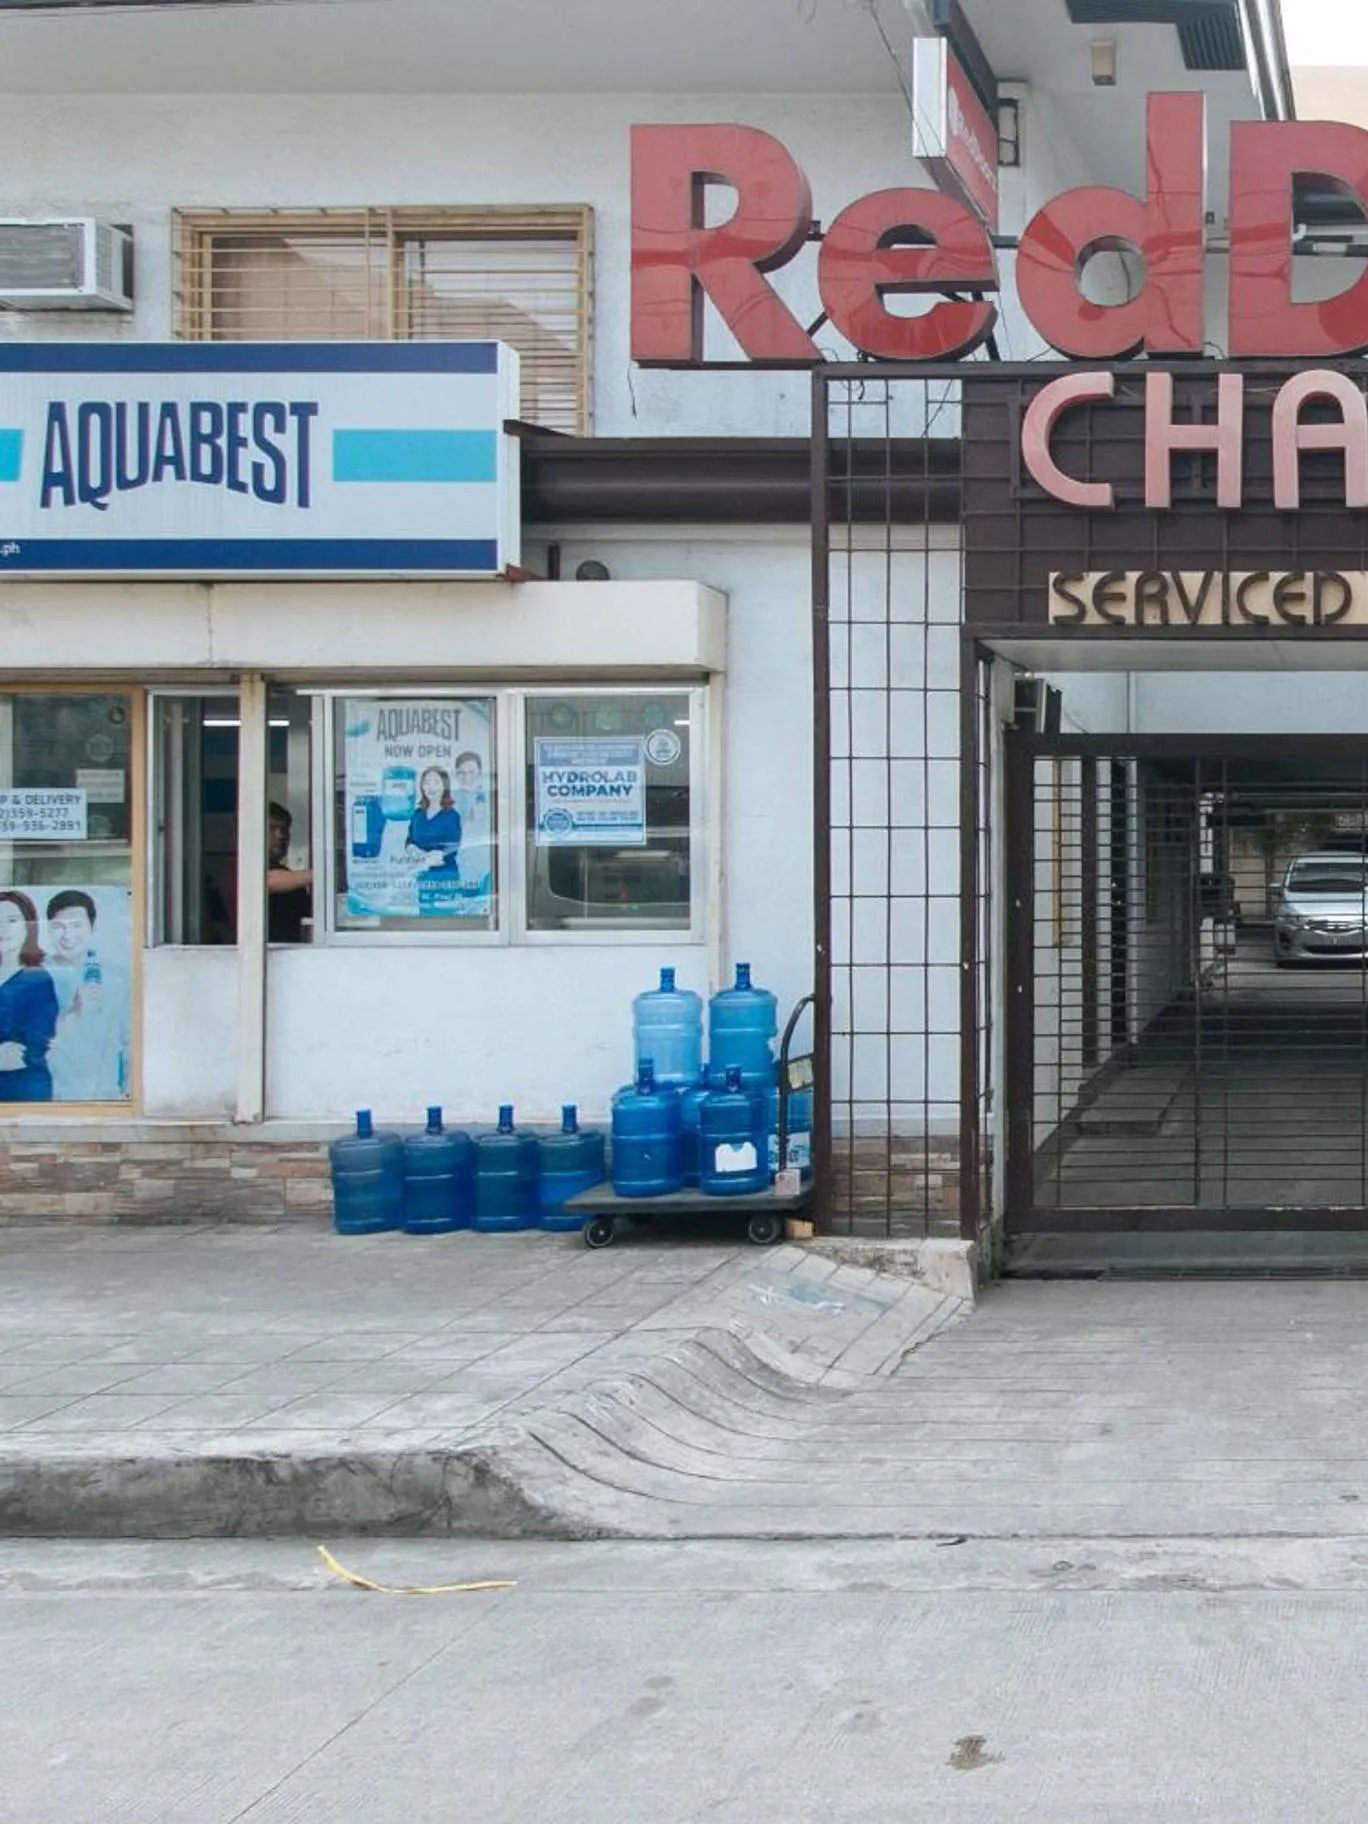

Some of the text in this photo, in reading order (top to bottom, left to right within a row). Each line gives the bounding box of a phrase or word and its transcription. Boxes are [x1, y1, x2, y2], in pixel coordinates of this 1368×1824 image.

[40, 401, 319, 511] AQUABEST
[1050, 571, 1353, 625] SERVICED
[376, 708, 463, 742] AQUABEST
[384, 744, 452, 758] NOW OPEN
[542, 771, 638, 784] HYDROLAB
[547, 784, 634, 798] COMPANY
[25, 794, 81, 805] DELIVERY
